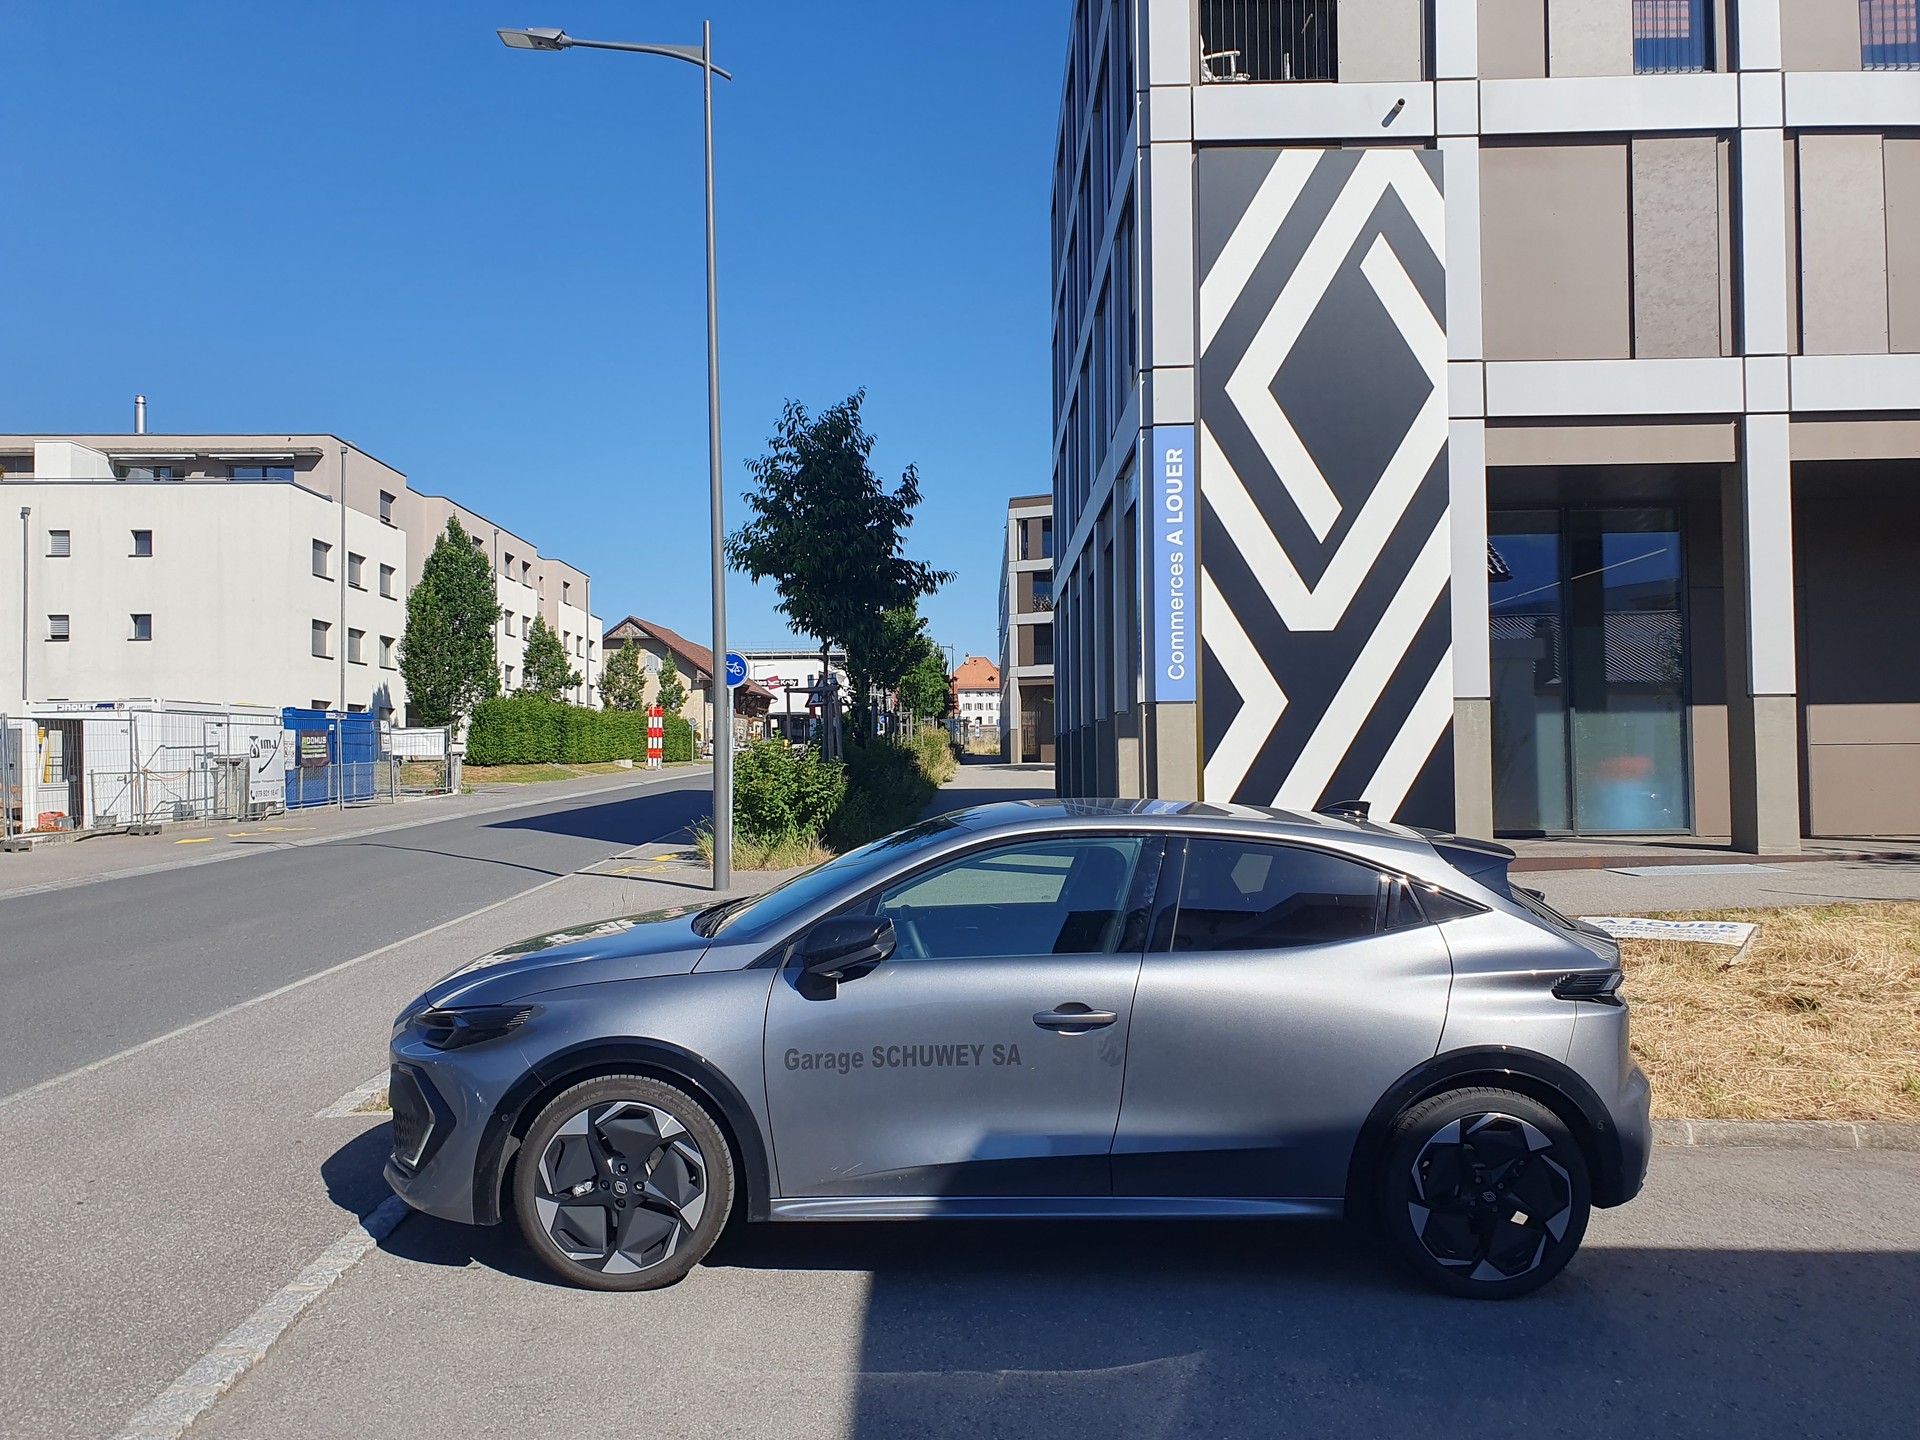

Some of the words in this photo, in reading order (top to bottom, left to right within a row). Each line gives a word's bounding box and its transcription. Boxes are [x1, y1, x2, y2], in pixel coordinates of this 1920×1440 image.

[1165, 448, 1184, 524] LOUER
[1166, 529, 1184, 546] A
[1167, 551, 1185, 681] Commerces
[306, 736, 327, 745] DOMUS
[1630, 920, 1738, 929] LOUER
[784, 1047, 865, 1075] Garage
[871, 1044, 985, 1068] SCHUWEY
[992, 1043, 1022, 1067] SA
